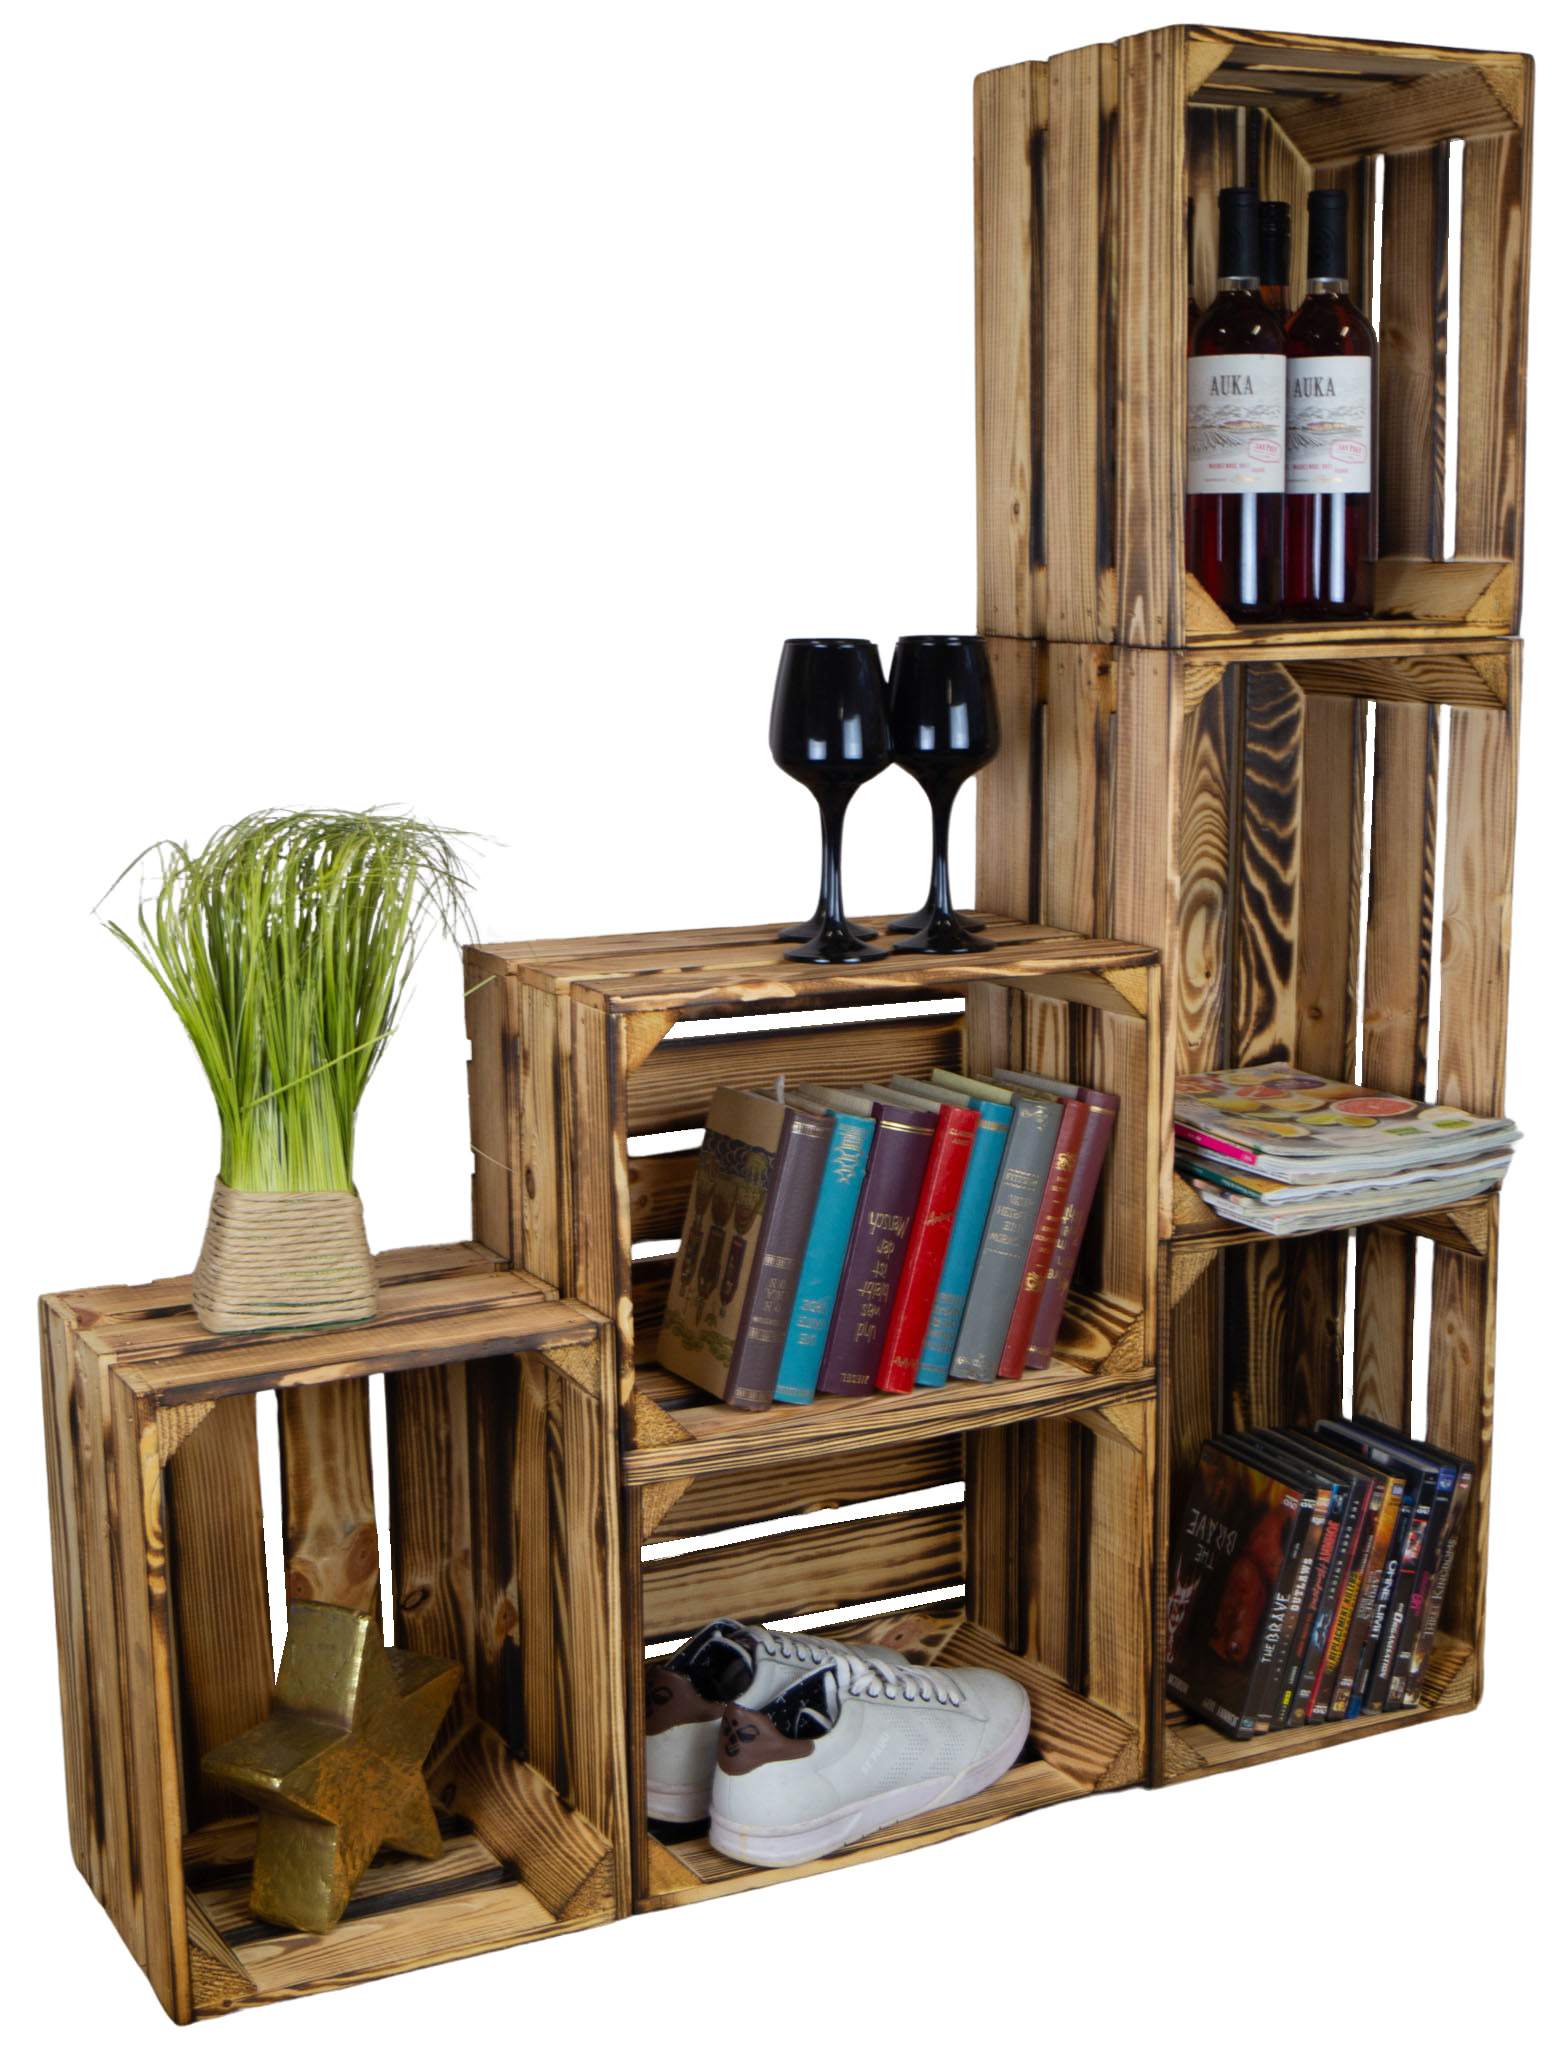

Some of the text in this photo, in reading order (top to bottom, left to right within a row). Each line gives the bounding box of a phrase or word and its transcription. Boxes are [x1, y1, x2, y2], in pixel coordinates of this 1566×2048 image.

[1209, 375, 1254, 396] AUKA
[1293, 377, 1336, 398] AUKA
[867, 1211, 910, 1239] Mensch
[1186, 1507, 1238, 1556] BRAVE
[1319, 1519, 1341, 1563] JOHNNY
[1194, 1543, 1214, 1571] THE
[1432, 1535, 1457, 1600] KINGDOMS
[1290, 1558, 1313, 1612] OUTLAWS
[1370, 1560, 1398, 1639] OHNE LIMIT
[1264, 1592, 1290, 1642] BRAVE
[1261, 1643, 1276, 1664] THE
[1379, 1611, 1404, 1680] ORGANISATION
